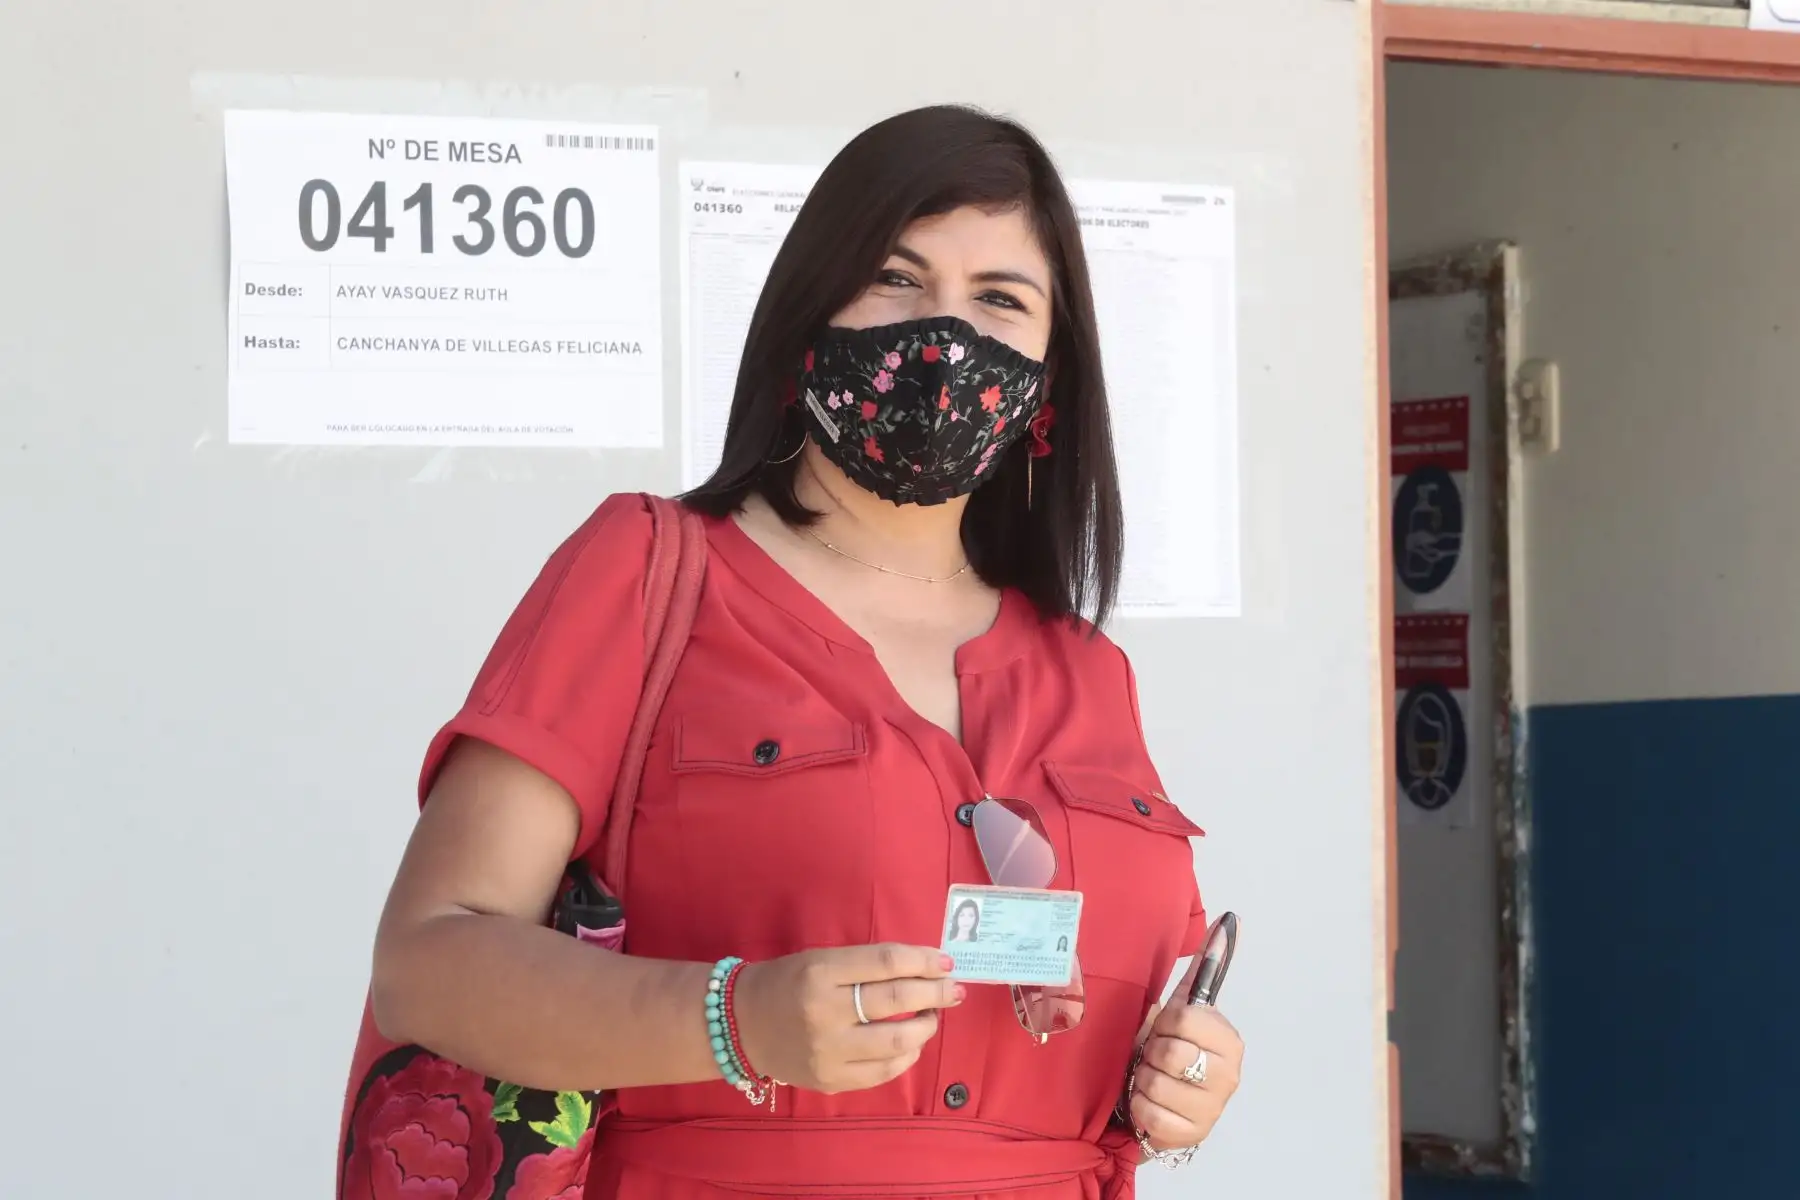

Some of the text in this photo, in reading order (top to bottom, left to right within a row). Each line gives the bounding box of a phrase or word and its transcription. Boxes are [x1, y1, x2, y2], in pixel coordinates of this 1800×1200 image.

[368, 138, 523, 164] Nº DE MESA
[693, 202, 743, 214] 041360
[774, 203, 803, 213] RELAC
[298, 178, 596, 259] 041360
[244, 282, 303, 298] Desde:
[336, 284, 508, 301] AYAY VASQUEZ RUTH
[243, 335, 301, 350] Hasta:
[336, 336, 643, 355] CANCHANYA DE VILLEGAS FELICIANA
